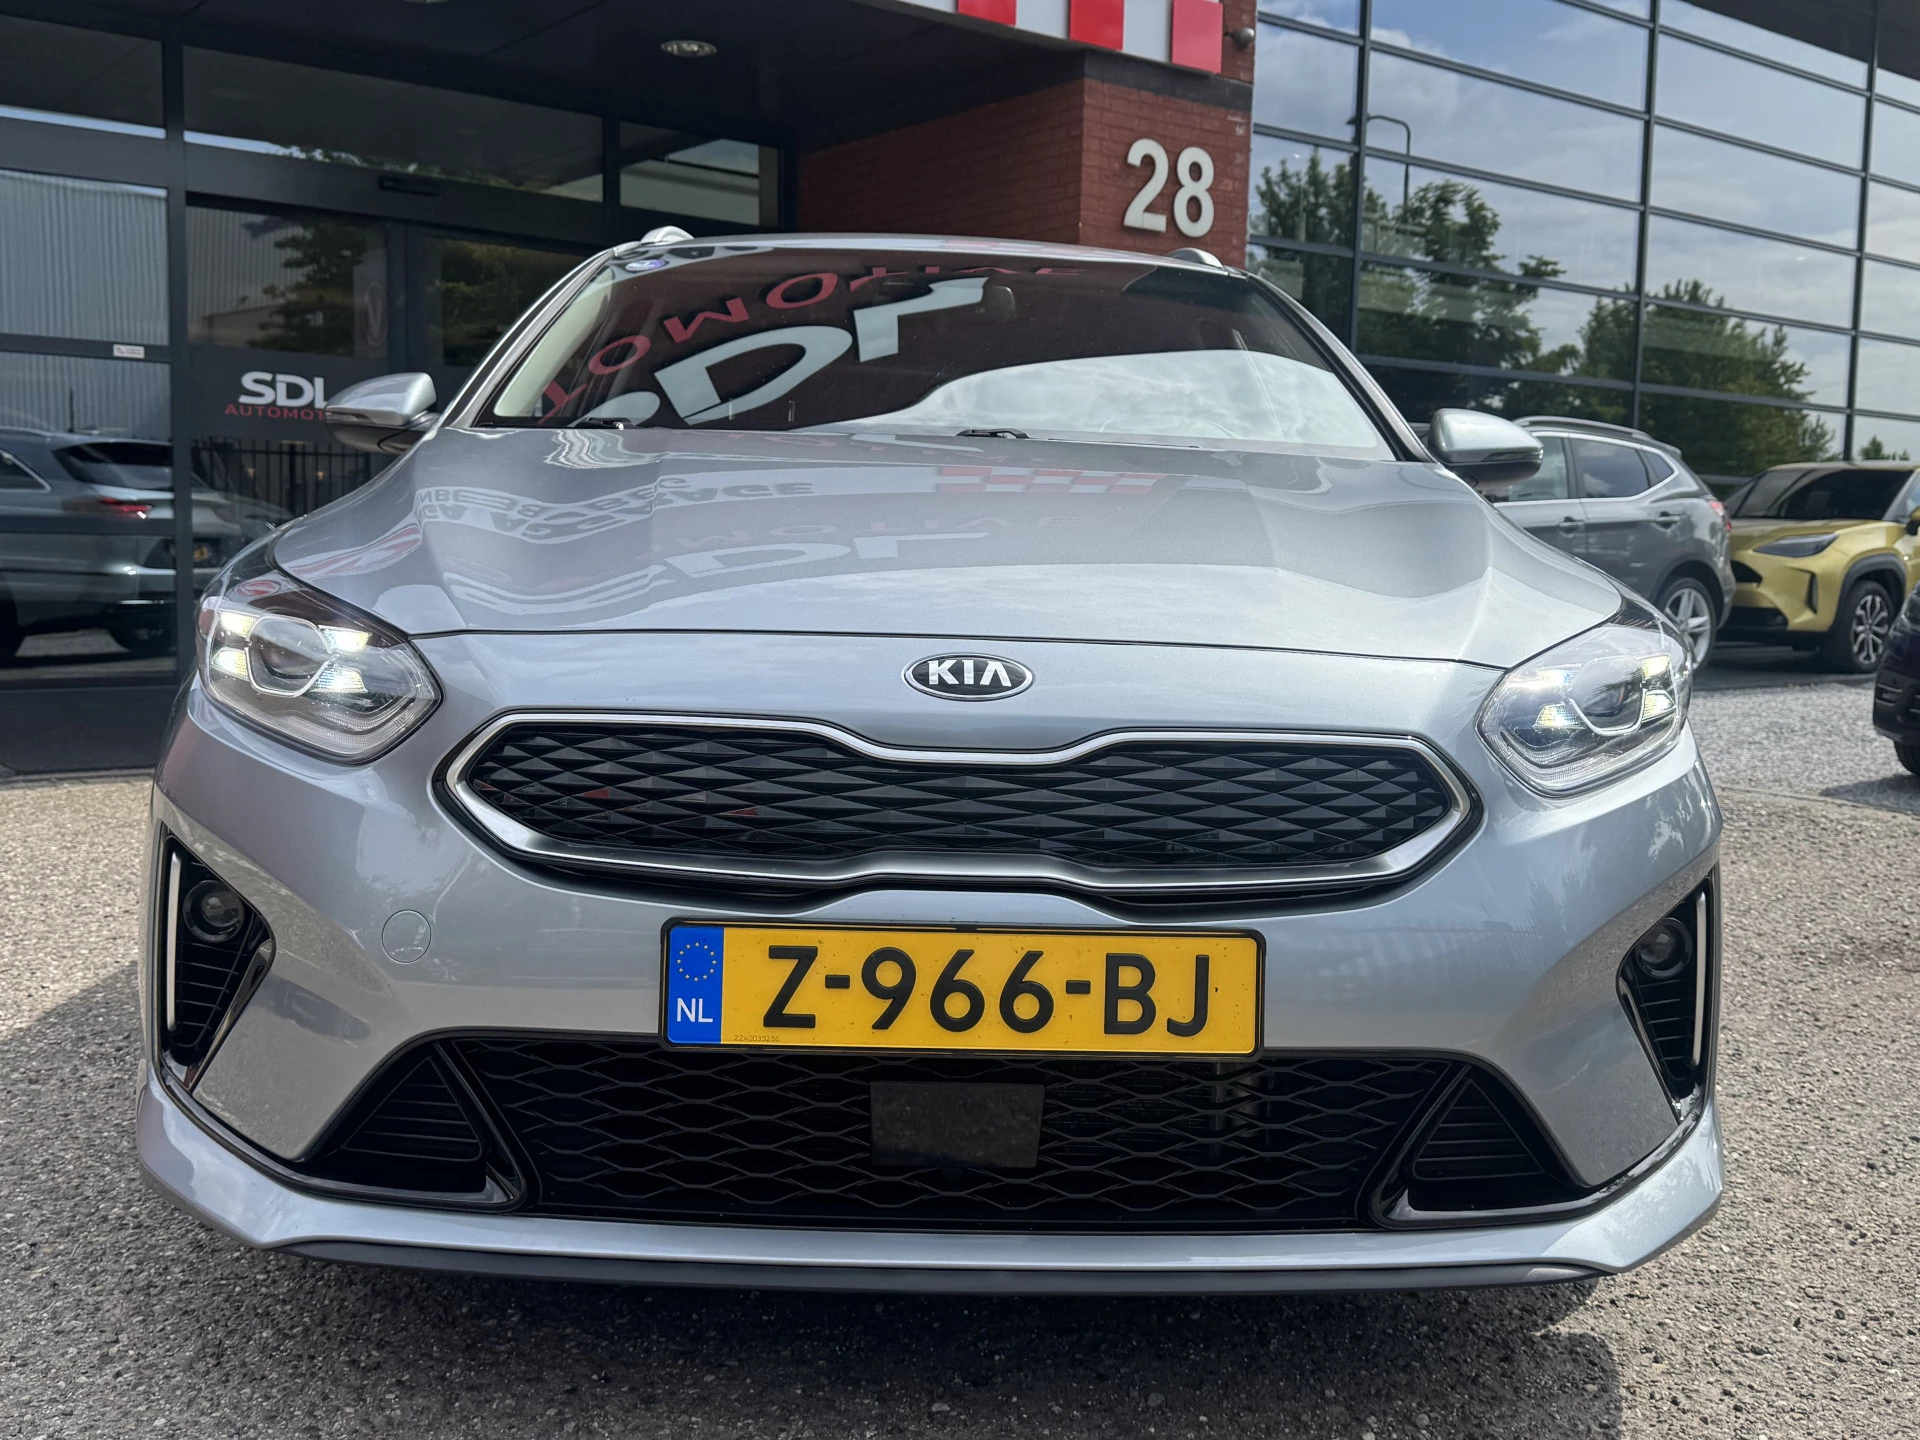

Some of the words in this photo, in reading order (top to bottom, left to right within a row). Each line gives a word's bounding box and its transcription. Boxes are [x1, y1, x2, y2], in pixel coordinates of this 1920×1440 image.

[1123, 138, 1215, 238] 28
[224, 403, 326, 421] AUTOMOT
[927, 659, 1012, 687] KIA
[763, 945, 1210, 1037] Z-966-BJ
[676, 997, 713, 1022] NL
